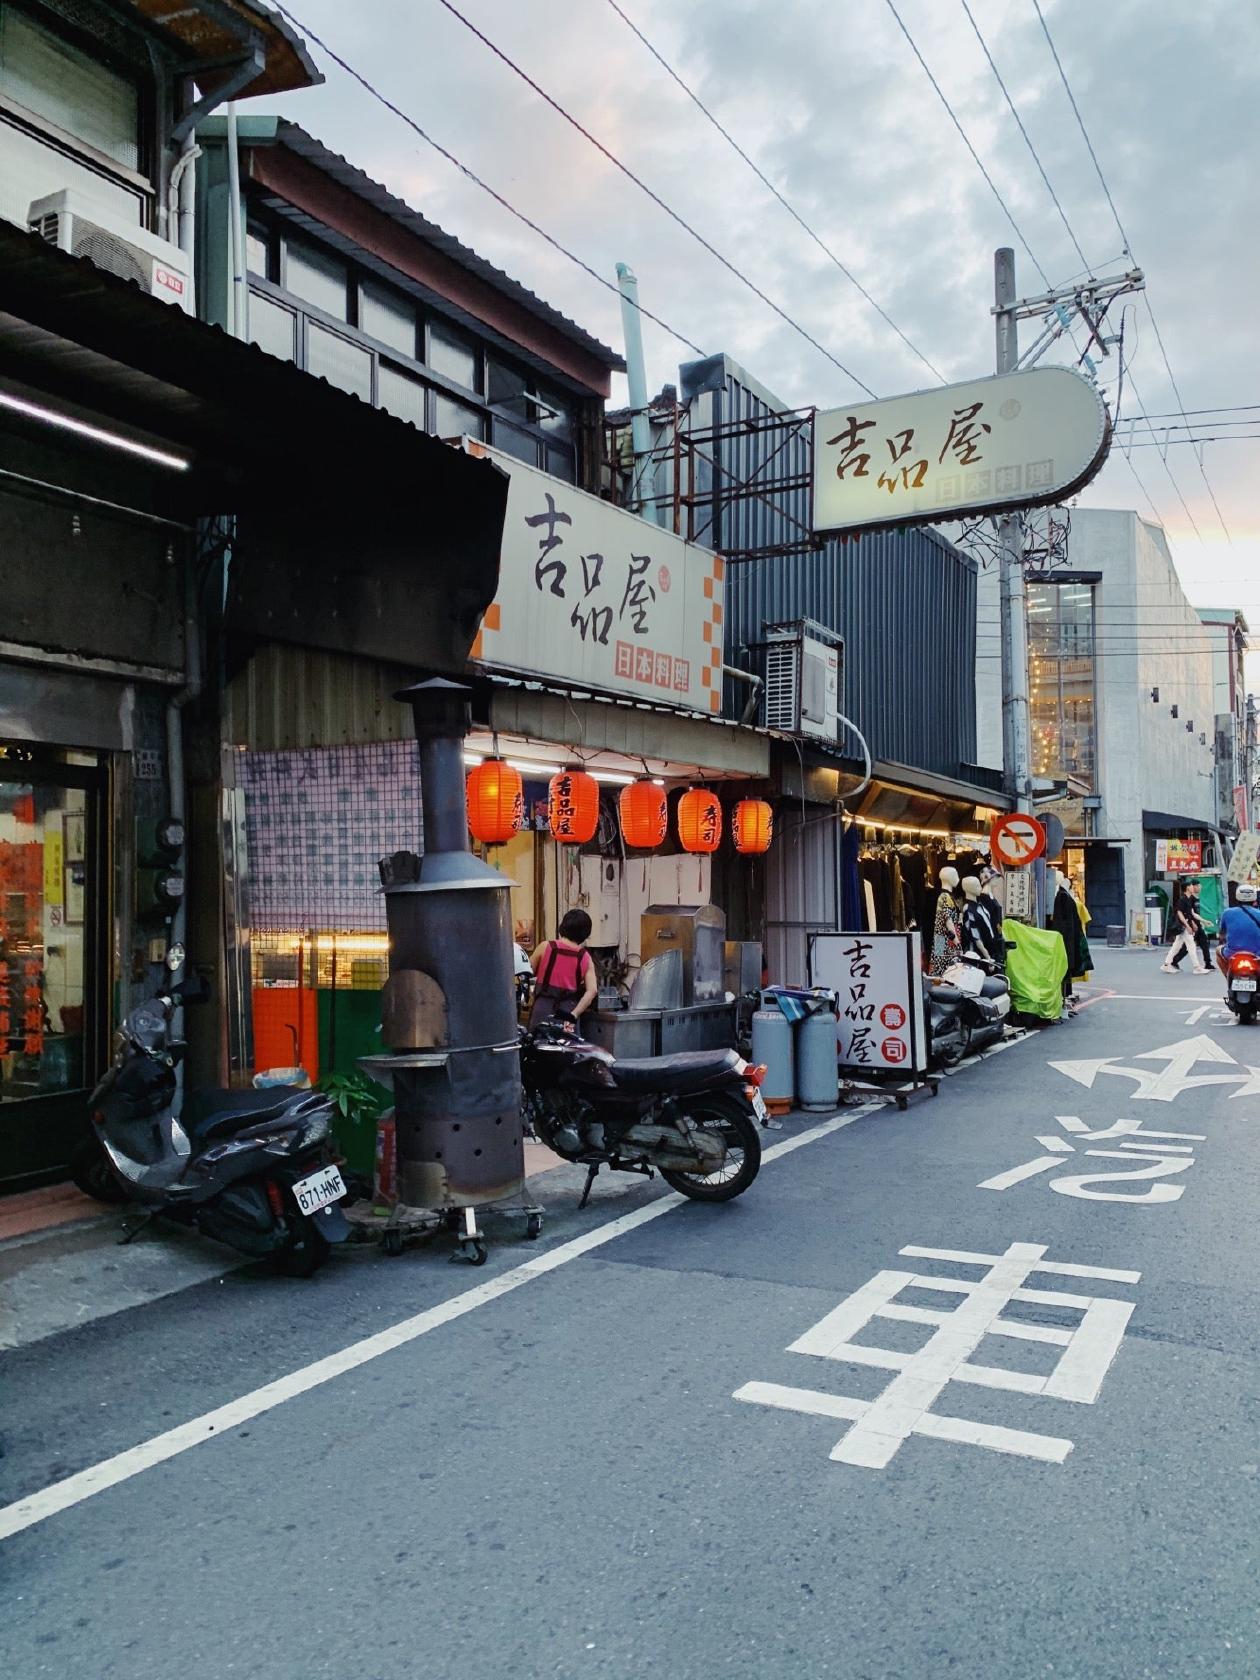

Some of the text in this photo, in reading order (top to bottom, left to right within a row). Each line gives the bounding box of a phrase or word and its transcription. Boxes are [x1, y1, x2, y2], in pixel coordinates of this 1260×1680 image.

[826, 402, 991, 494] 吉品屋
[935, 459, 1056, 503] 日本料理
[524, 492, 656, 646] 吉品屋
[615, 640, 689, 692] 日本料理
[556, 776, 575, 835] 吉品屋
[843, 940, 876, 1063] 吉品屋
[299, 1175, 341, 1210] 871-HNF
